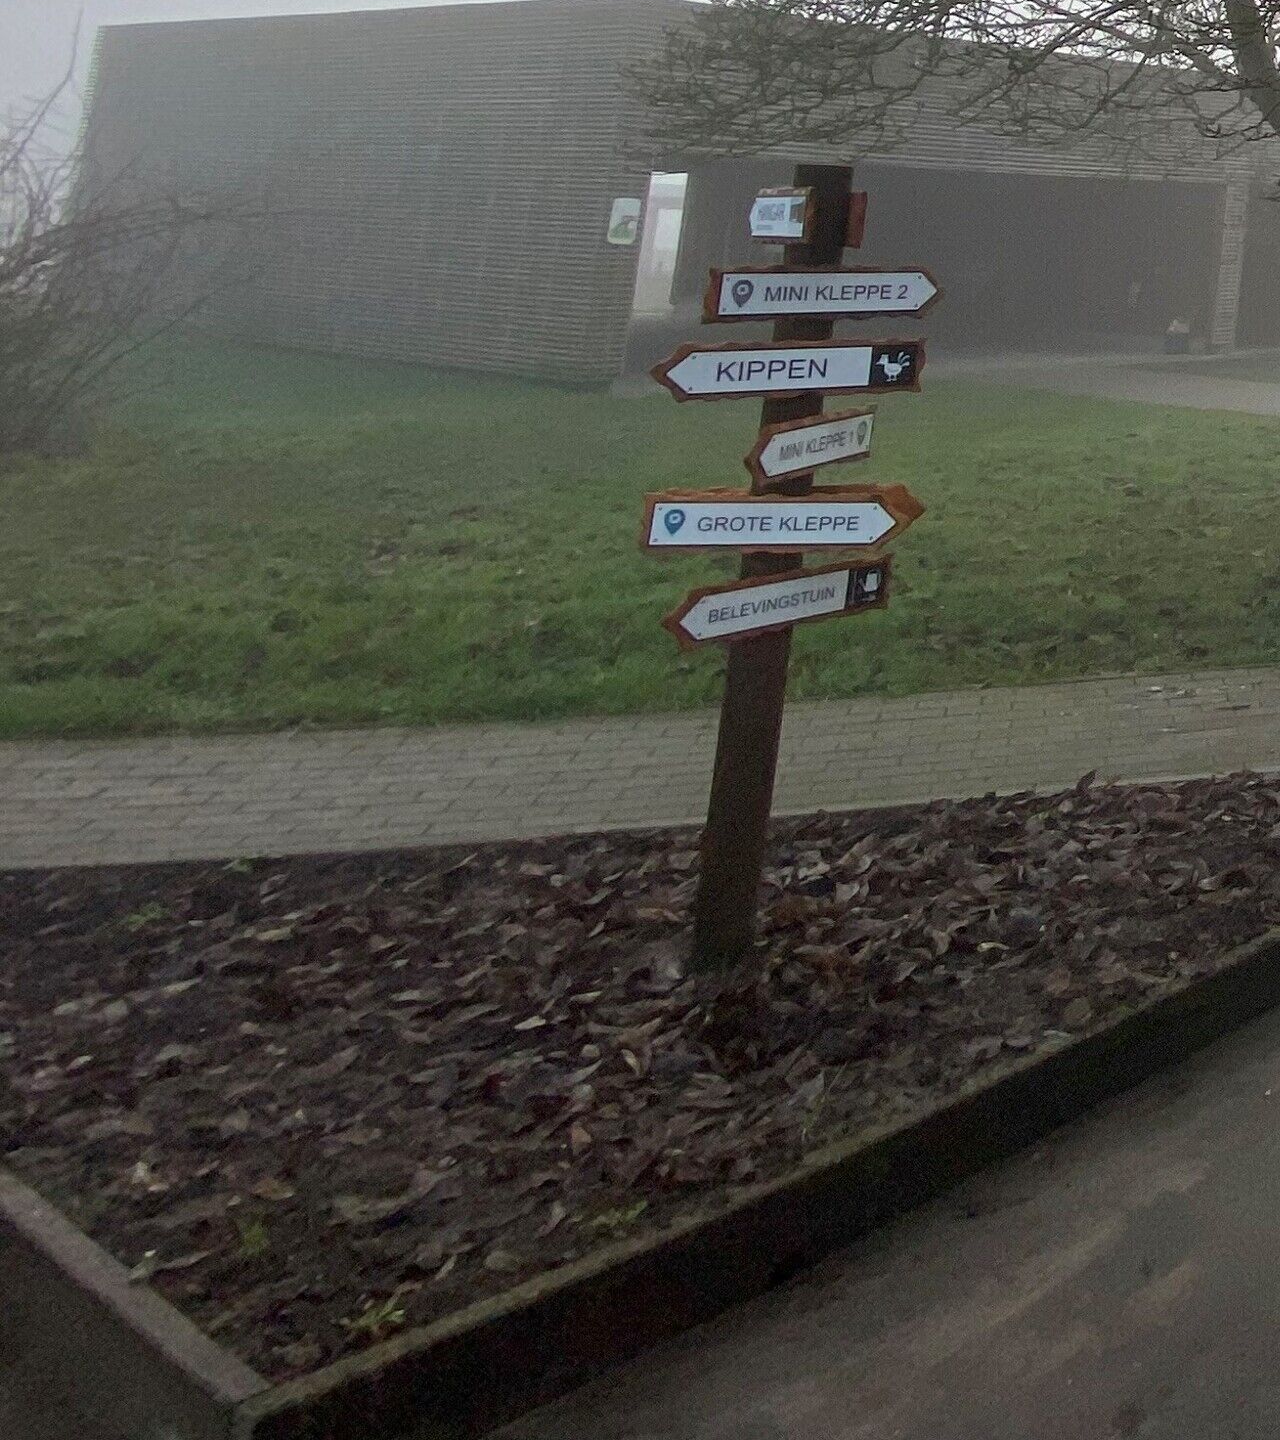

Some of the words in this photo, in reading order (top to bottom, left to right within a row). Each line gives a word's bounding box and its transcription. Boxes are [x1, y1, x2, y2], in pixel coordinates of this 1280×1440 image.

[764, 285, 809, 302] MINI
[815, 284, 893, 301] KLEPPE
[897, 284, 908, 300] 2
[716, 358, 828, 382] KIPPEN
[806, 430, 847, 454] KLEPPE
[697, 516, 774, 532] GROTE
[778, 516, 861, 532] KLEPPE
[708, 586, 836, 625] BELEVINGSTUIN
